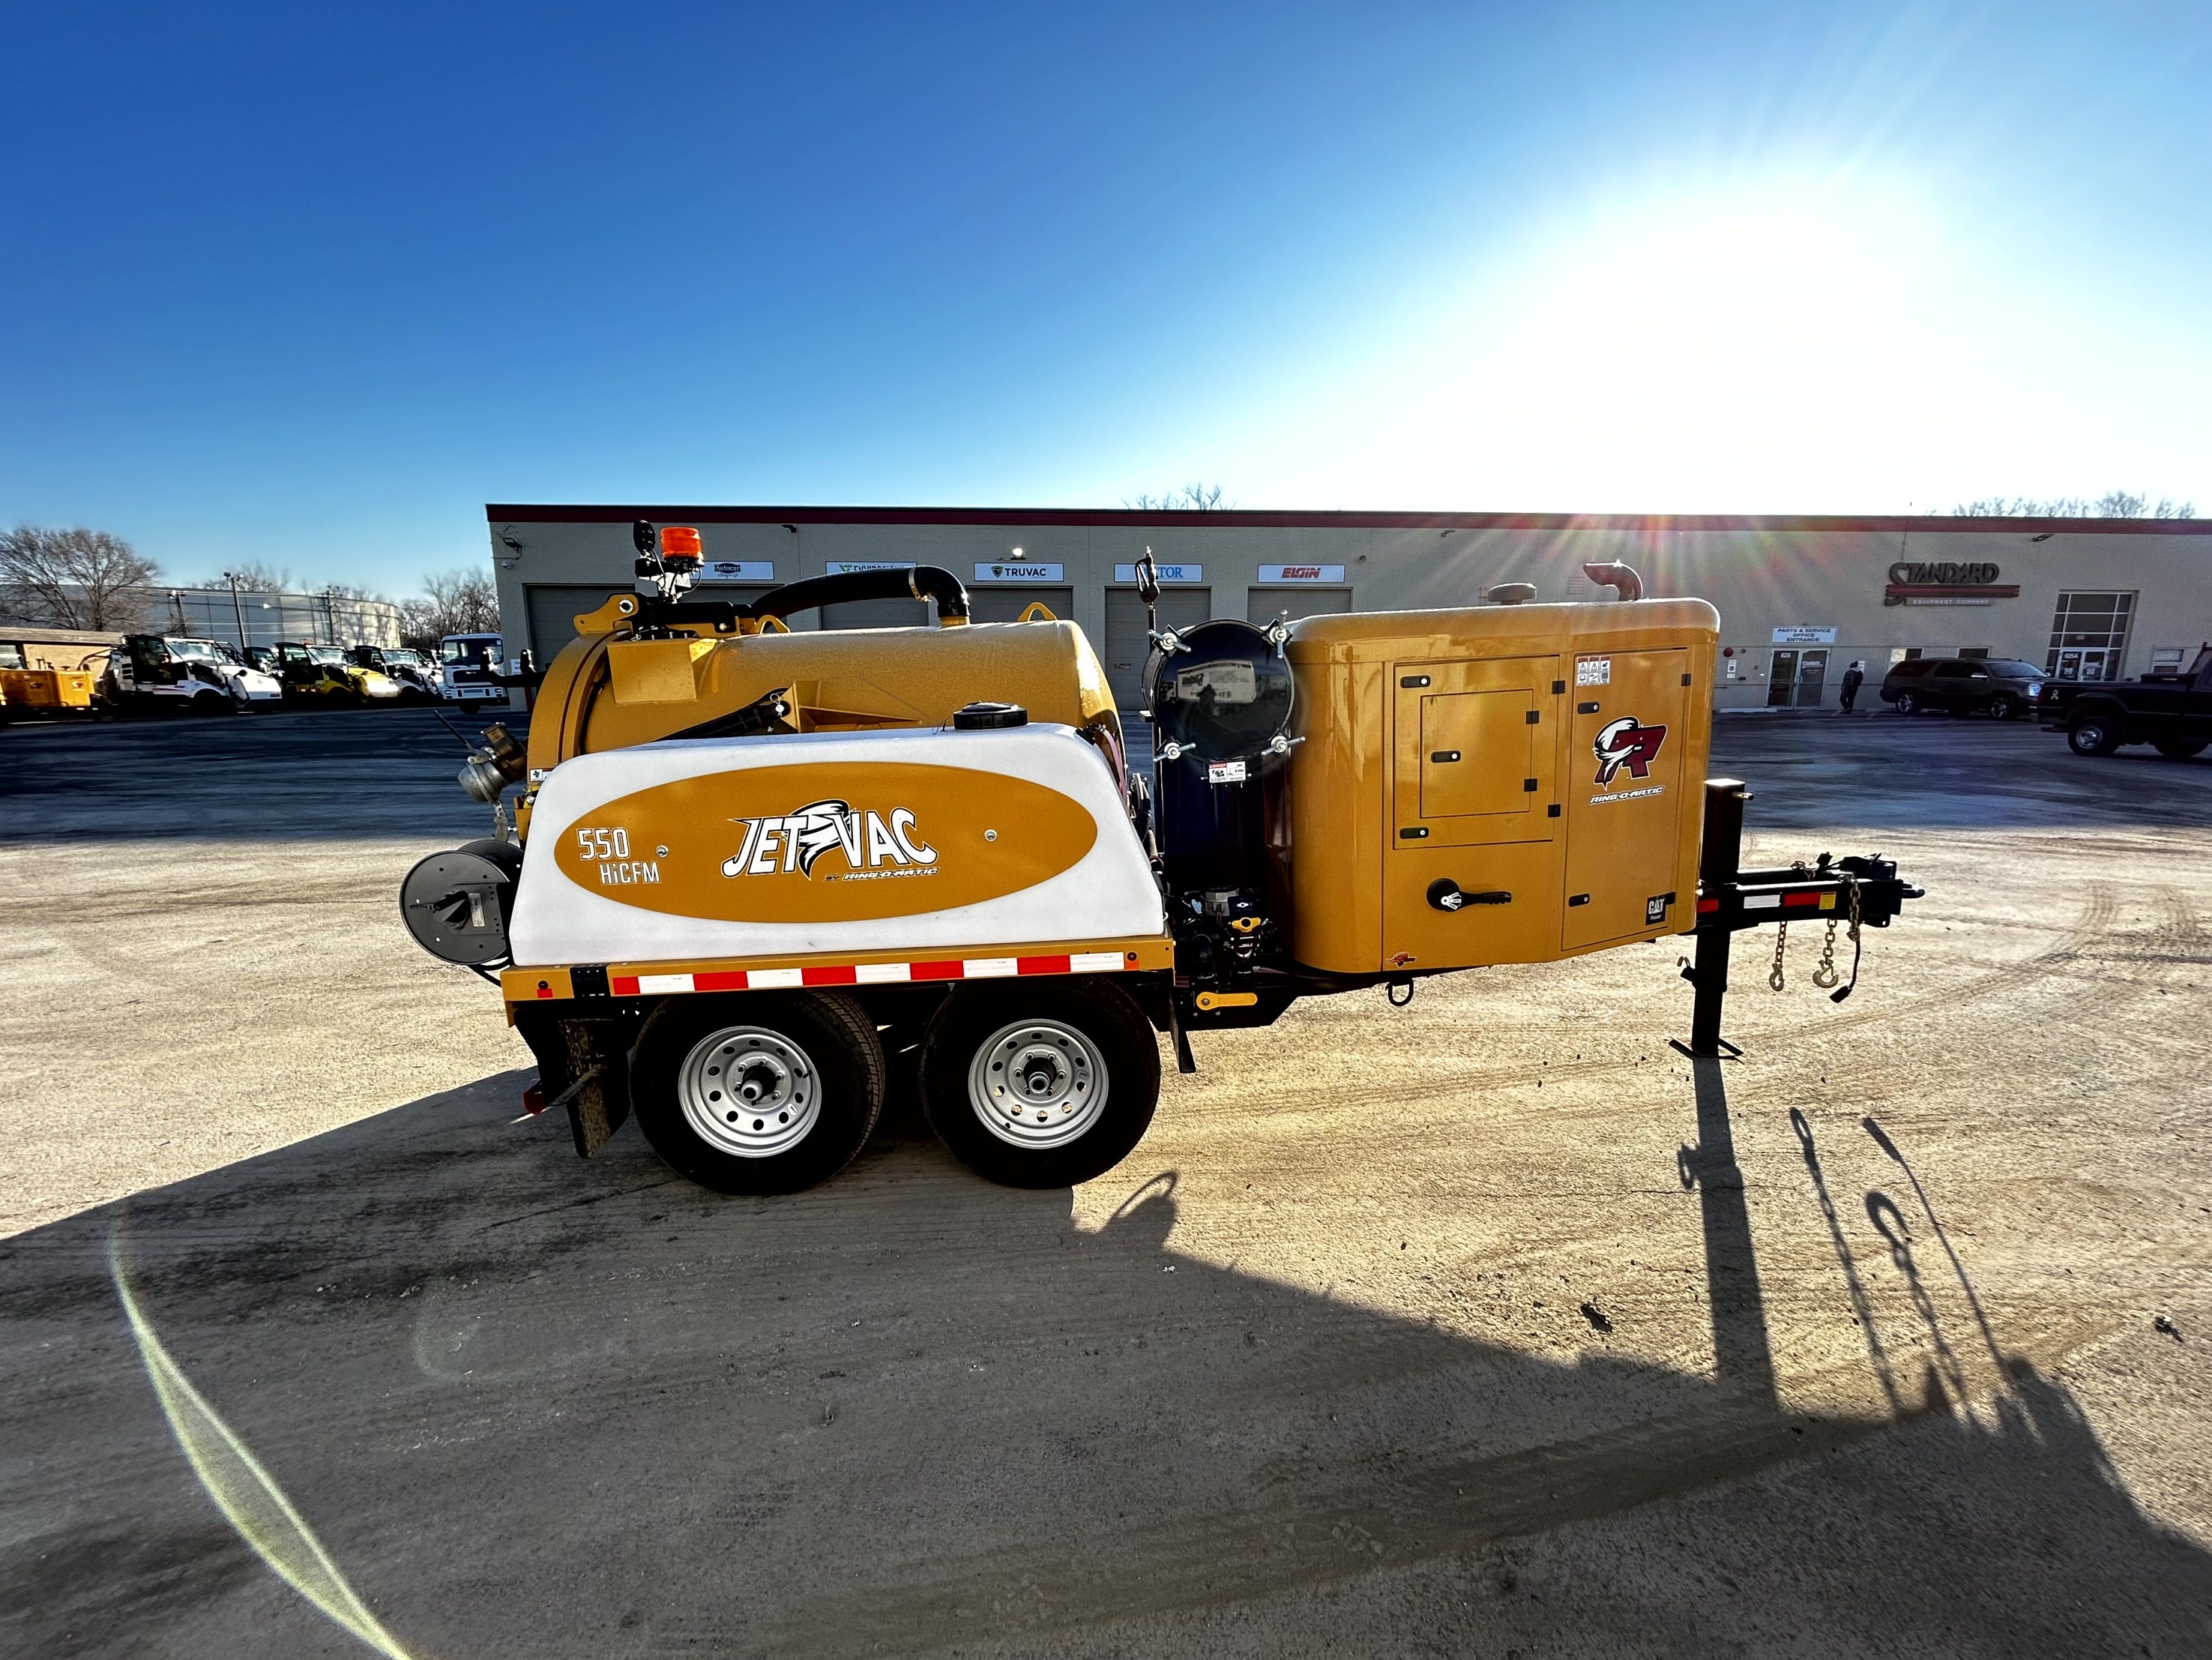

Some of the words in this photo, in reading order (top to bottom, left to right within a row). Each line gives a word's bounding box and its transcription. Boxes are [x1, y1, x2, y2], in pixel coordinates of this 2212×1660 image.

[1004, 568, 1047, 577] TRUVAC
[1589, 786, 1665, 805] RING-O-MATIC
[576, 828, 630, 861] 550
[599, 861, 660, 885] HiCFM
[843, 867, 939, 880] RING-O-MATIC
[1648, 898, 1665, 915] CAT
